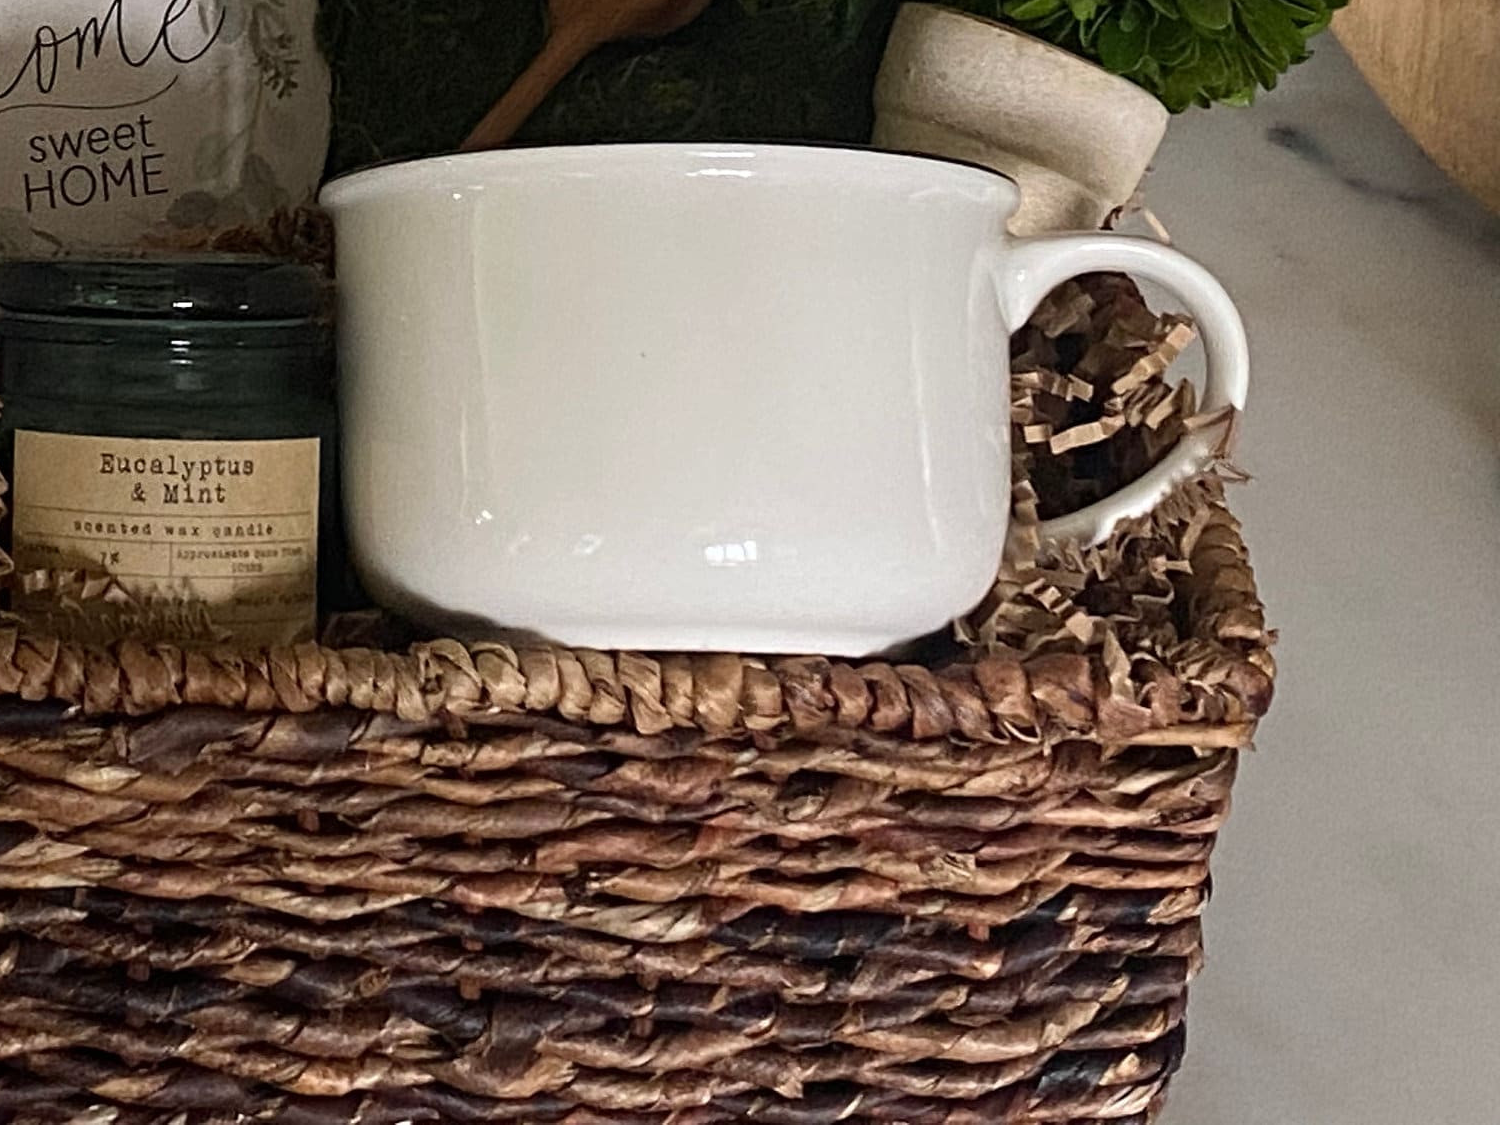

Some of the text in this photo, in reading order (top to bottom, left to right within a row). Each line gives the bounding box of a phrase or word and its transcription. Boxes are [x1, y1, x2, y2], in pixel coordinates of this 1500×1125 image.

[29, 114, 156, 164] sweet
[23, 153, 169, 213] HOME
[99, 452, 254, 482] Eucalyptus
[130, 481, 227, 504] & Mint
[73, 519, 274, 538] scented wax candle
